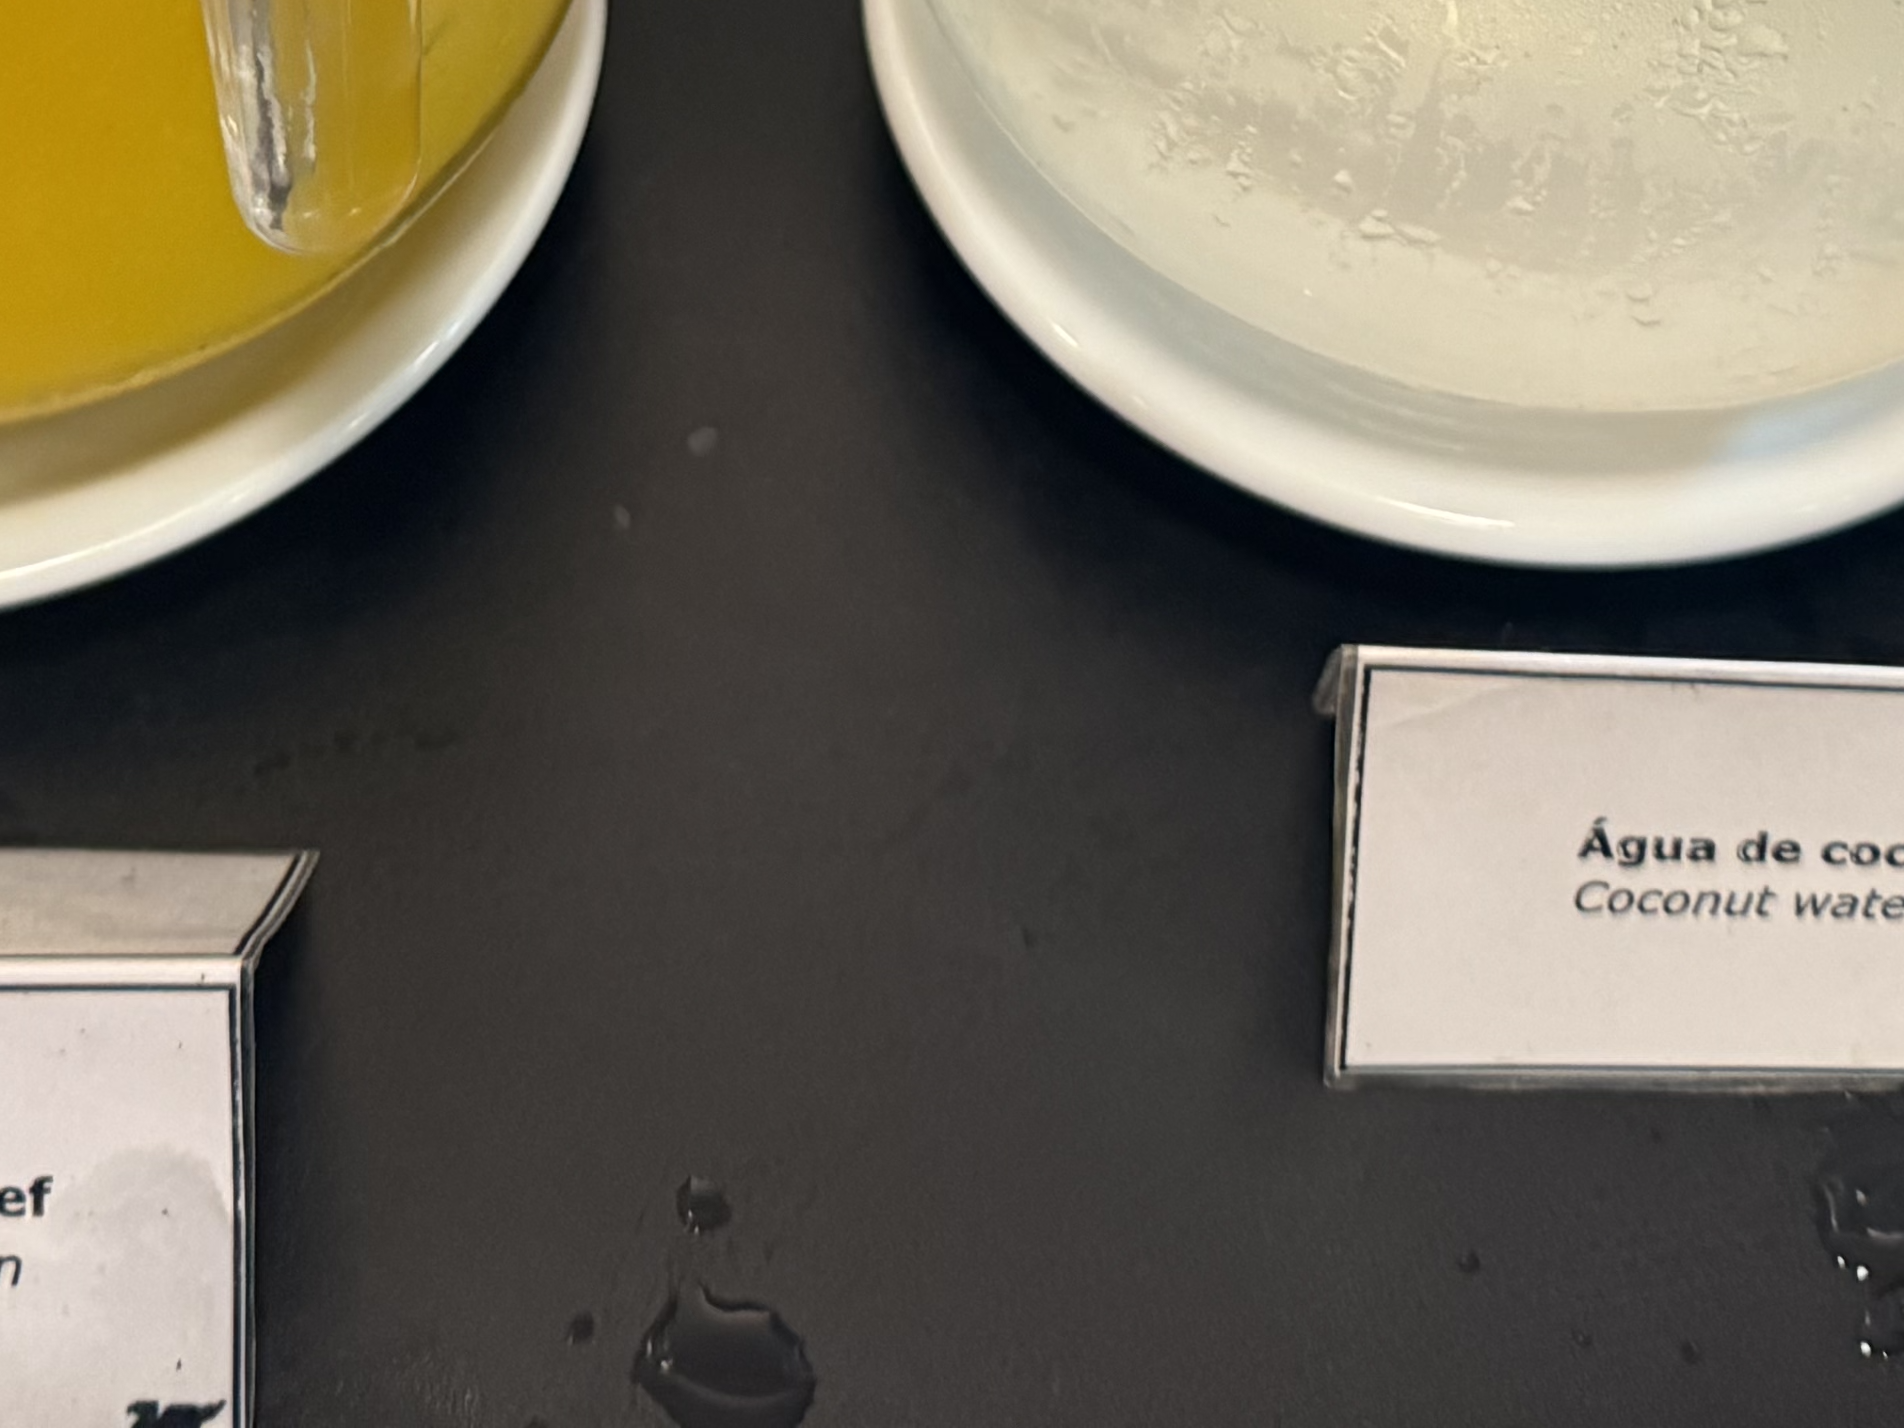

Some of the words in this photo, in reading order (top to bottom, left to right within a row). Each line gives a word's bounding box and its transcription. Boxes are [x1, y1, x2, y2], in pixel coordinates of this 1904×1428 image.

[1577, 816, 1717, 868] Água
[1735, 831, 1802, 864] de
[1573, 879, 1776, 918] Coconut
